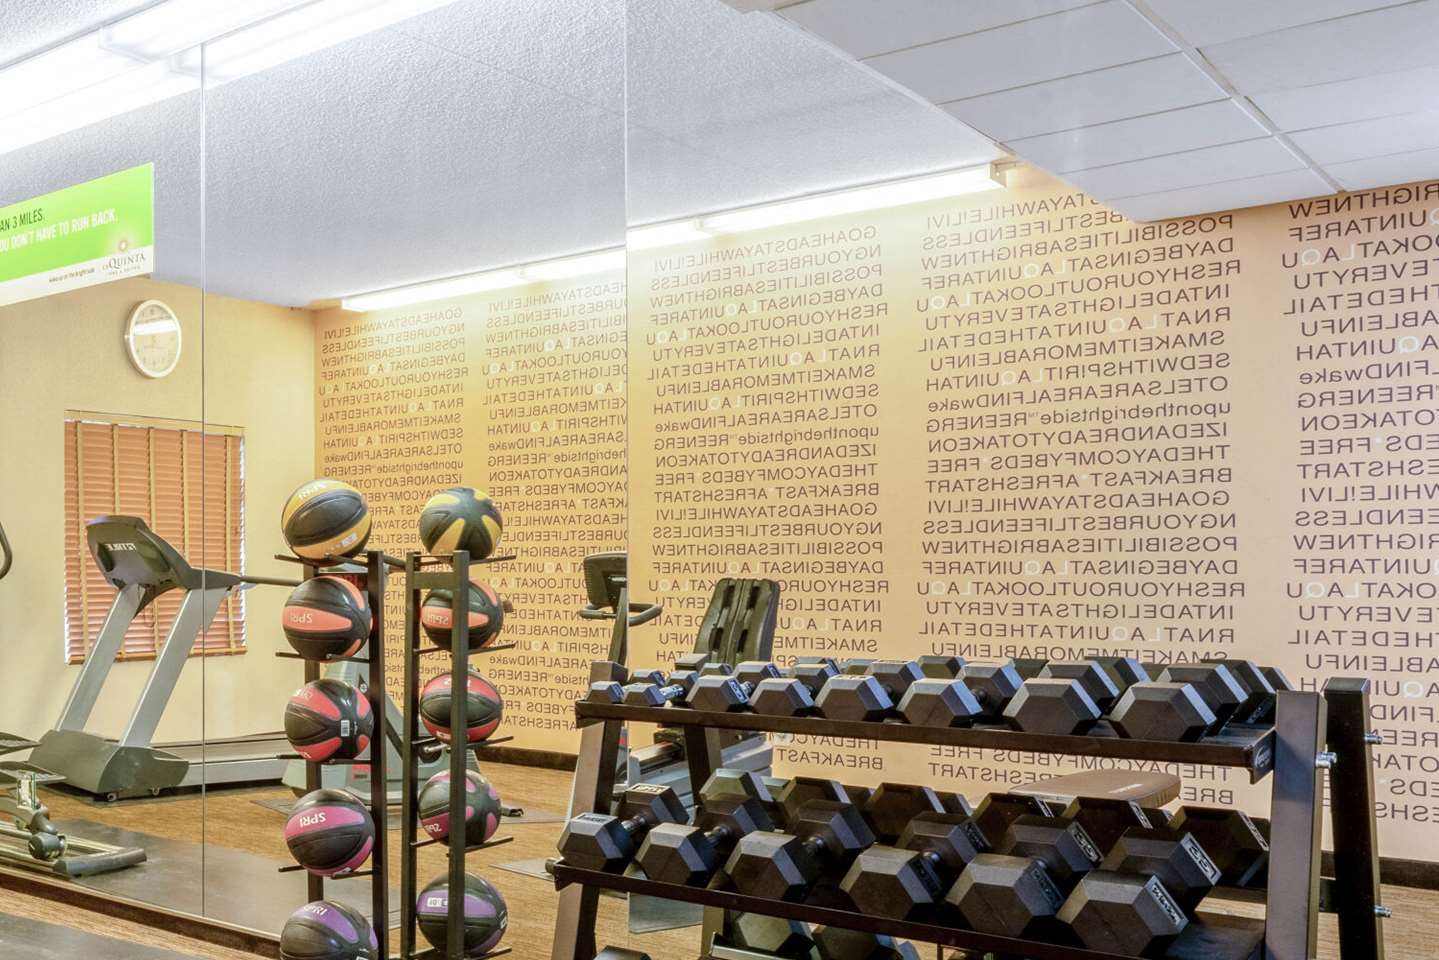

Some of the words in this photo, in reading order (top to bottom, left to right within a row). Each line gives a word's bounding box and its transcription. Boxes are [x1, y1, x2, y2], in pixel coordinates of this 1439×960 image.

[13, 215, 18, 228] 3
[12, 232, 35, 249] DON'T
[36, 225, 57, 242] HAVE
[59, 221, 69, 236] TO
[72, 216, 89, 232] RUN
[298, 812, 327, 828] SPRI
